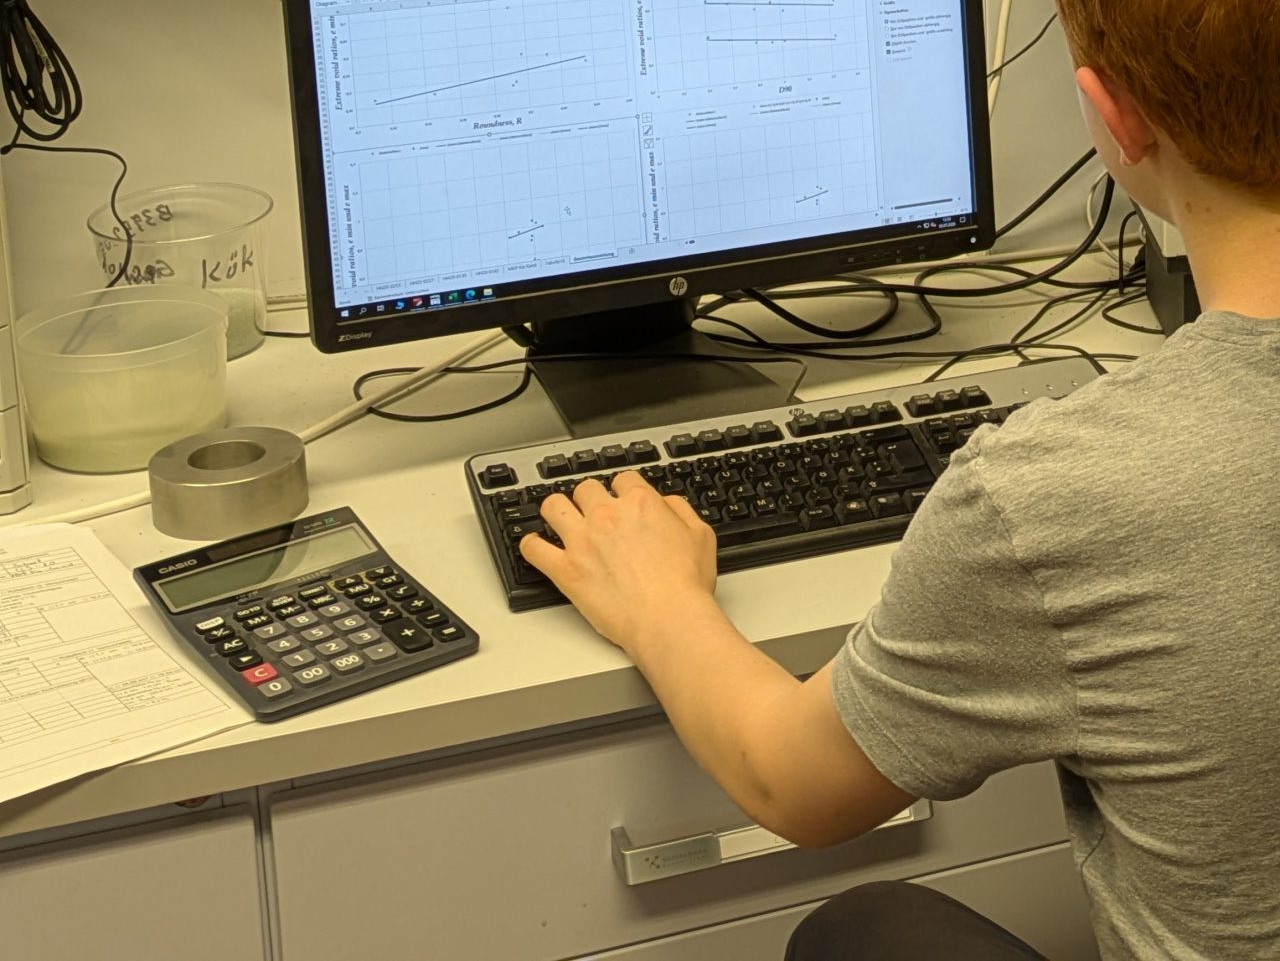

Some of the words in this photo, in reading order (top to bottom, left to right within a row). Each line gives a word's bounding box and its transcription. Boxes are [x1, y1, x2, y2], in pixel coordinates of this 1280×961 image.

[158, 558, 198, 575] CASIO
[328, 606, 341, 614] 9
[297, 616, 309, 624] 8
[344, 619, 357, 627] 6
[263, 627, 275, 635] 7
[311, 628, 323, 637] 5
[223, 638, 243, 651] AC
[279, 640, 291, 648] 4
[327, 643, 340, 651] 2
[336, 655, 360, 666] 000
[254, 668, 268, 677] C
[302, 668, 323, 679] 00
[268, 682, 282, 691] 0
